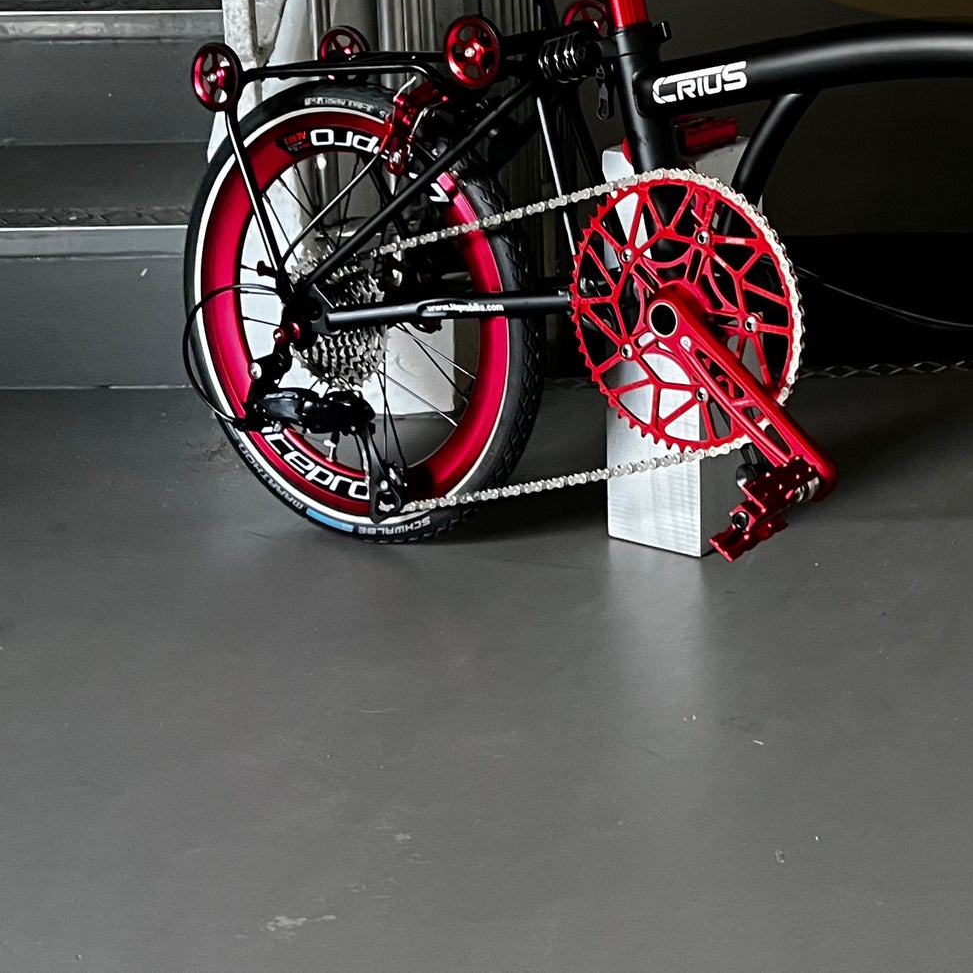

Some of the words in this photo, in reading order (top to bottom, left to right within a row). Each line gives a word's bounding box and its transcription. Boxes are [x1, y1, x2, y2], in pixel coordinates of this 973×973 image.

[652, 60, 748, 104] CRIUS
[237, 442, 304, 510] MARATHON
[357, 516, 431, 535] SCHWALBE
